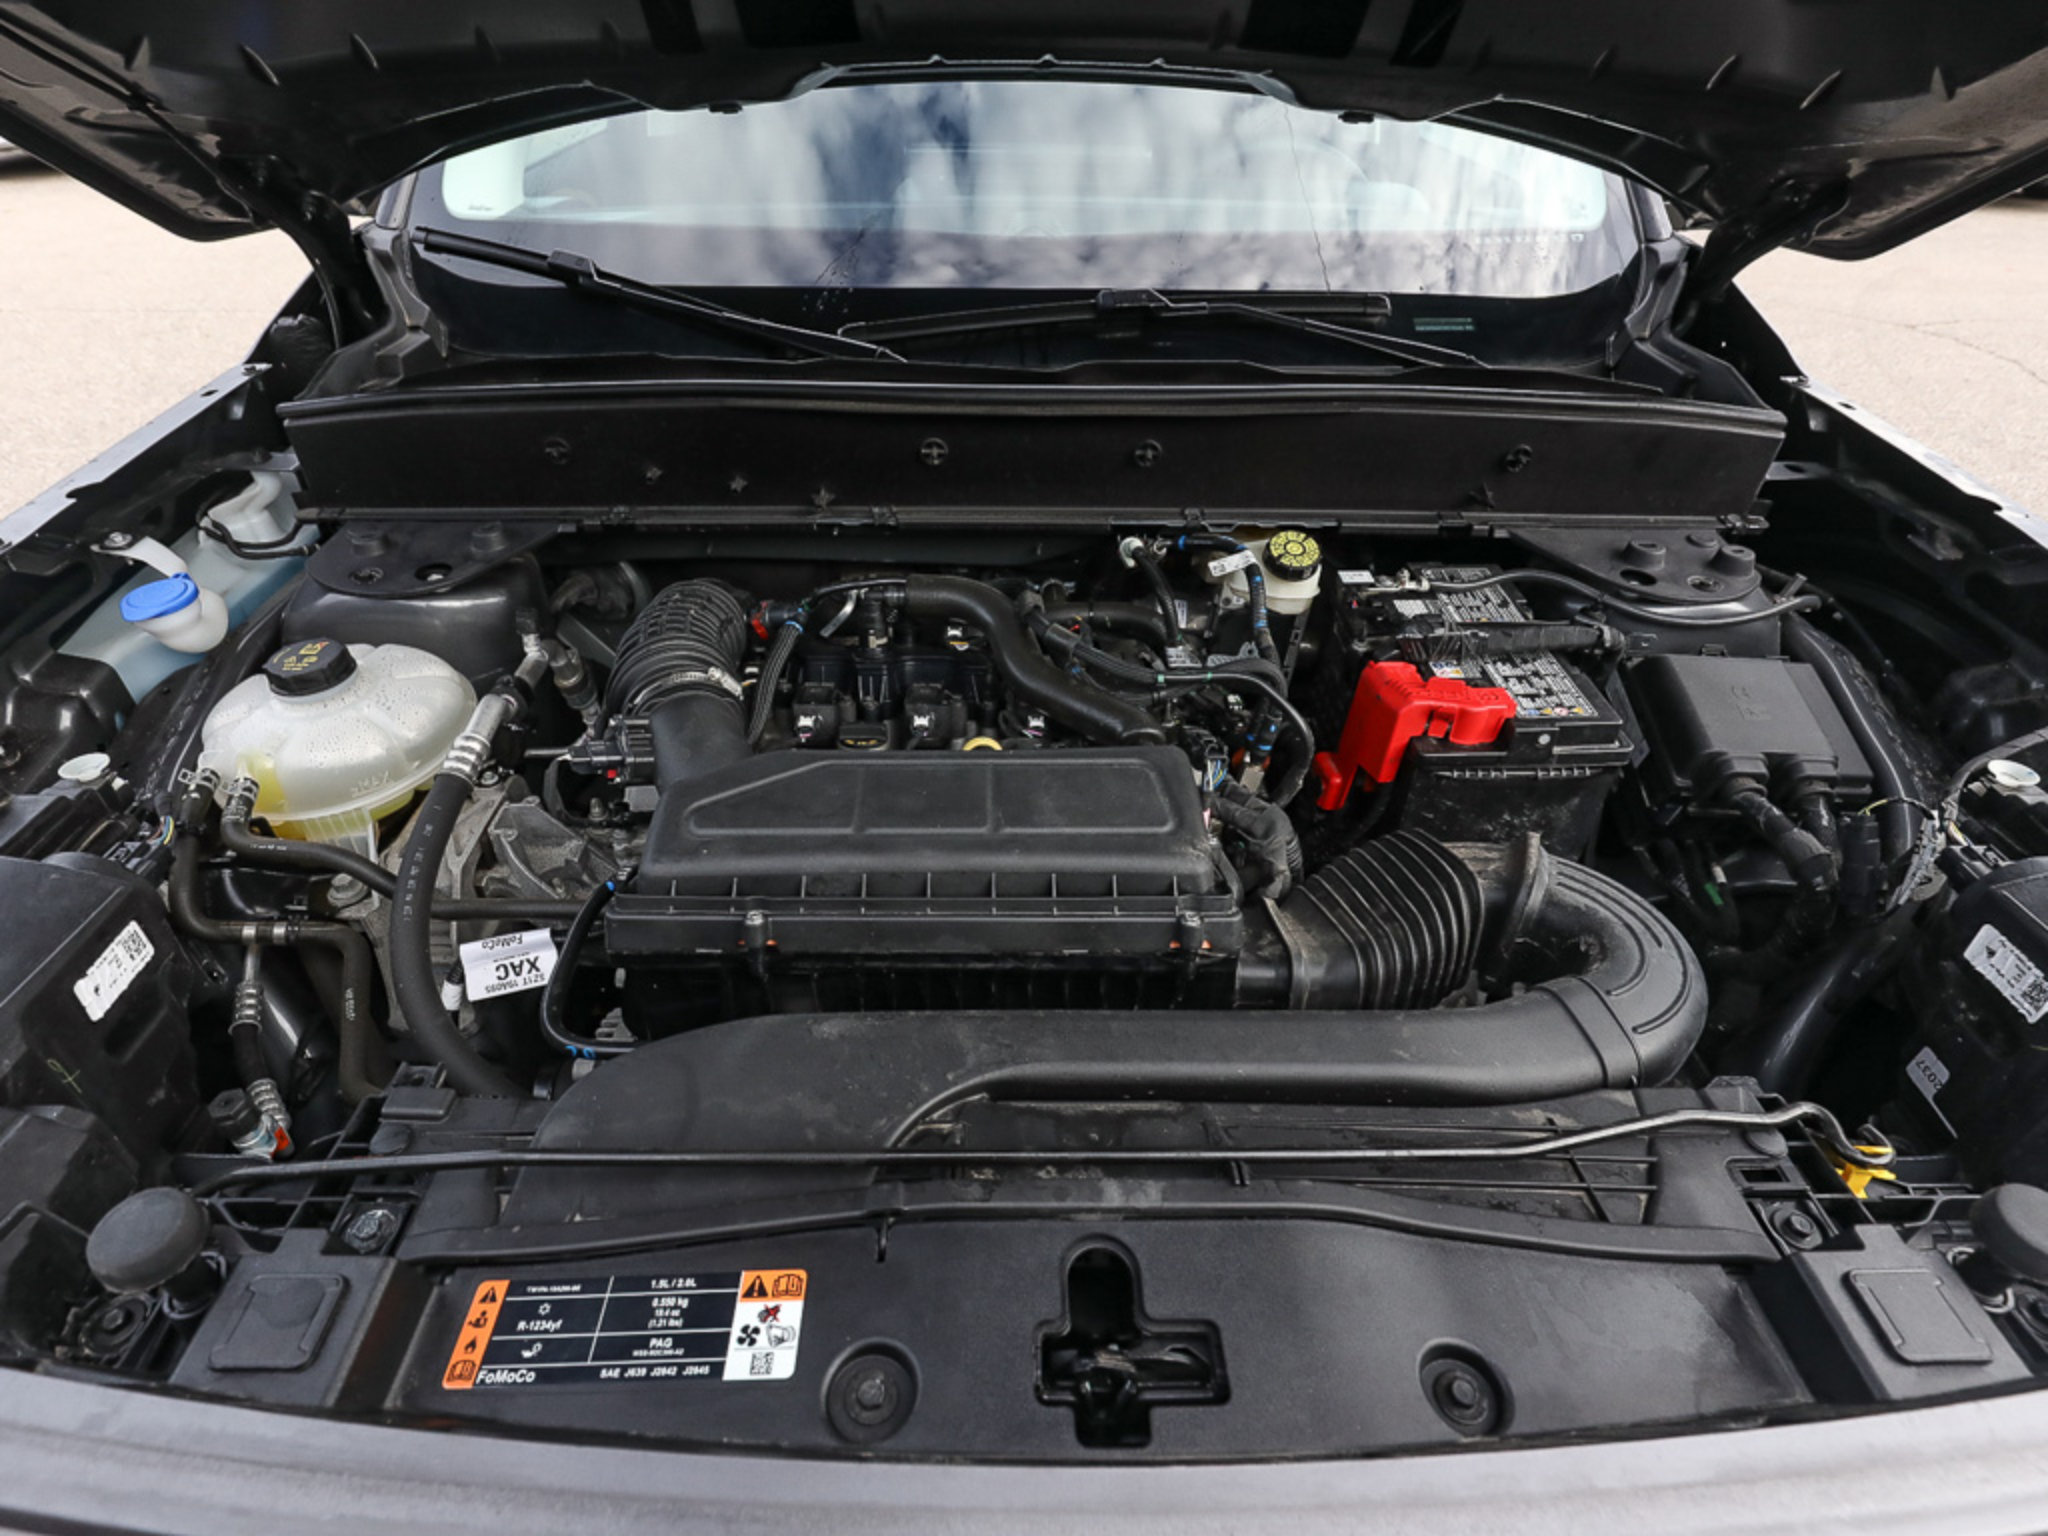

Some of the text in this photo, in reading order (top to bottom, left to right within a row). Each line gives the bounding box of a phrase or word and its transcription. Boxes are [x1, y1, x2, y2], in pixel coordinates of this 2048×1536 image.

[482, 934, 522, 950] FoMoCo
[495, 956, 540, 980] XAC
[1915, 1060, 1943, 1090] 2037
[677, 1296, 689, 1309] kg
[517, 1317, 564, 1333] R-1234yf
[649, 1337, 673, 1349] PAG
[475, 1369, 537, 1384] FoMoCo
[599, 1367, 621, 1379] SAE
